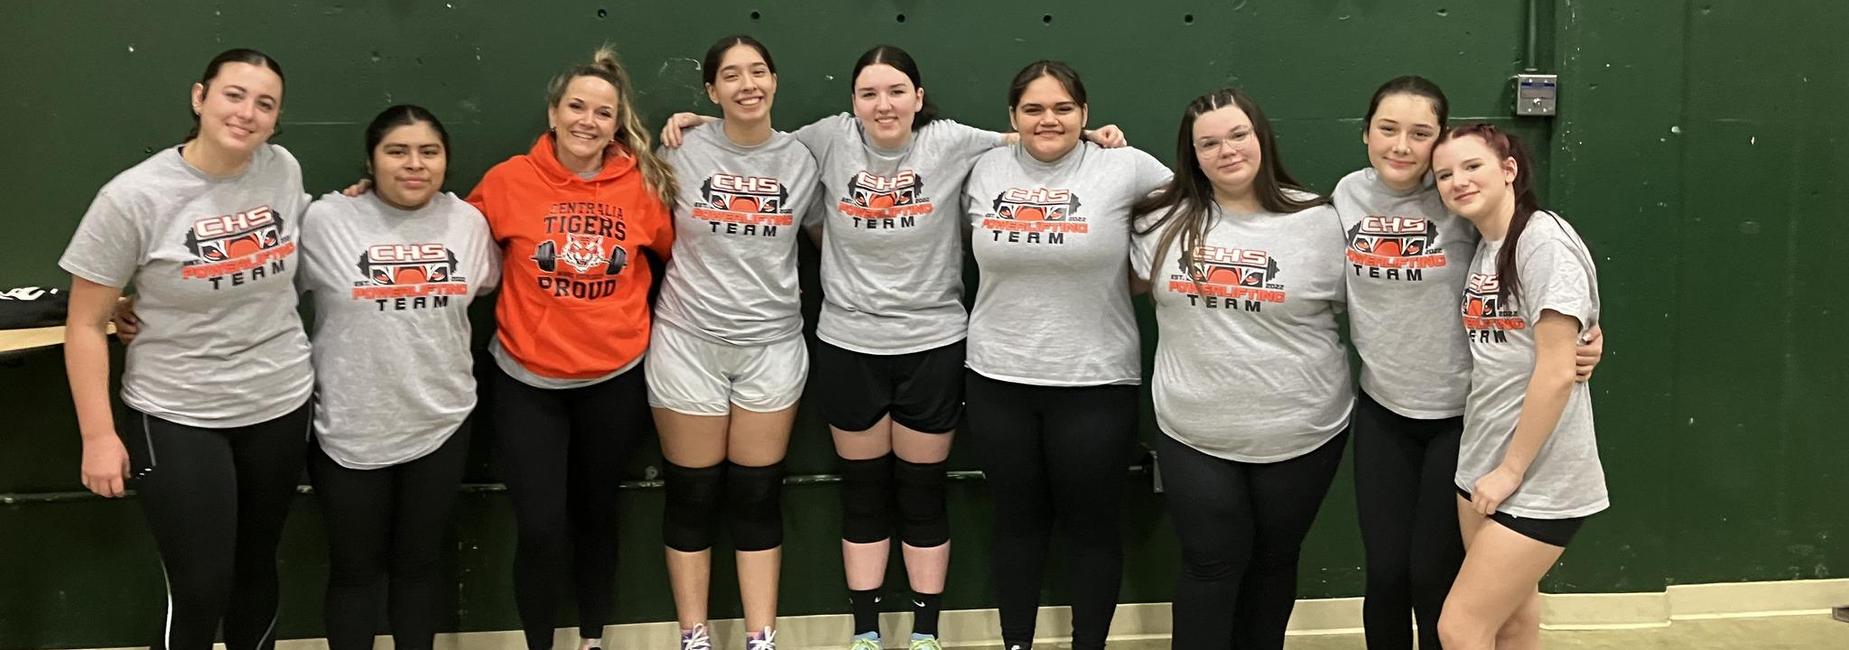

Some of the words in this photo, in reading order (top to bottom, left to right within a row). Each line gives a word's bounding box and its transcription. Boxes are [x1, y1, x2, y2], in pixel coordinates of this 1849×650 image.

[711, 173, 780, 193] CHS
[857, 169, 914, 190] CHS
[1004, 187, 1070, 203] CHS
[193, 204, 275, 239] CHS
[543, 215, 626, 241] TIGERS
[709, 221, 777, 237] TEAM
[852, 216, 915, 229] TEAM
[982, 218, 1088, 234] POWERLIFTING
[1360, 215, 1426, 233] CHS
[992, 230, 1065, 244] TEAM
[369, 243, 446, 262] CHS
[1191, 245, 1268, 265] CHS
[208, 259, 285, 290] TEAM
[1353, 264, 1423, 281] TEAM
[537, 276, 616, 300] PROUD
[1265, 282, 1285, 291] 2022
[376, 296, 449, 311] TEAM
[1186, 294, 1261, 313] TEAM
[1469, 329, 1507, 343] EAM
